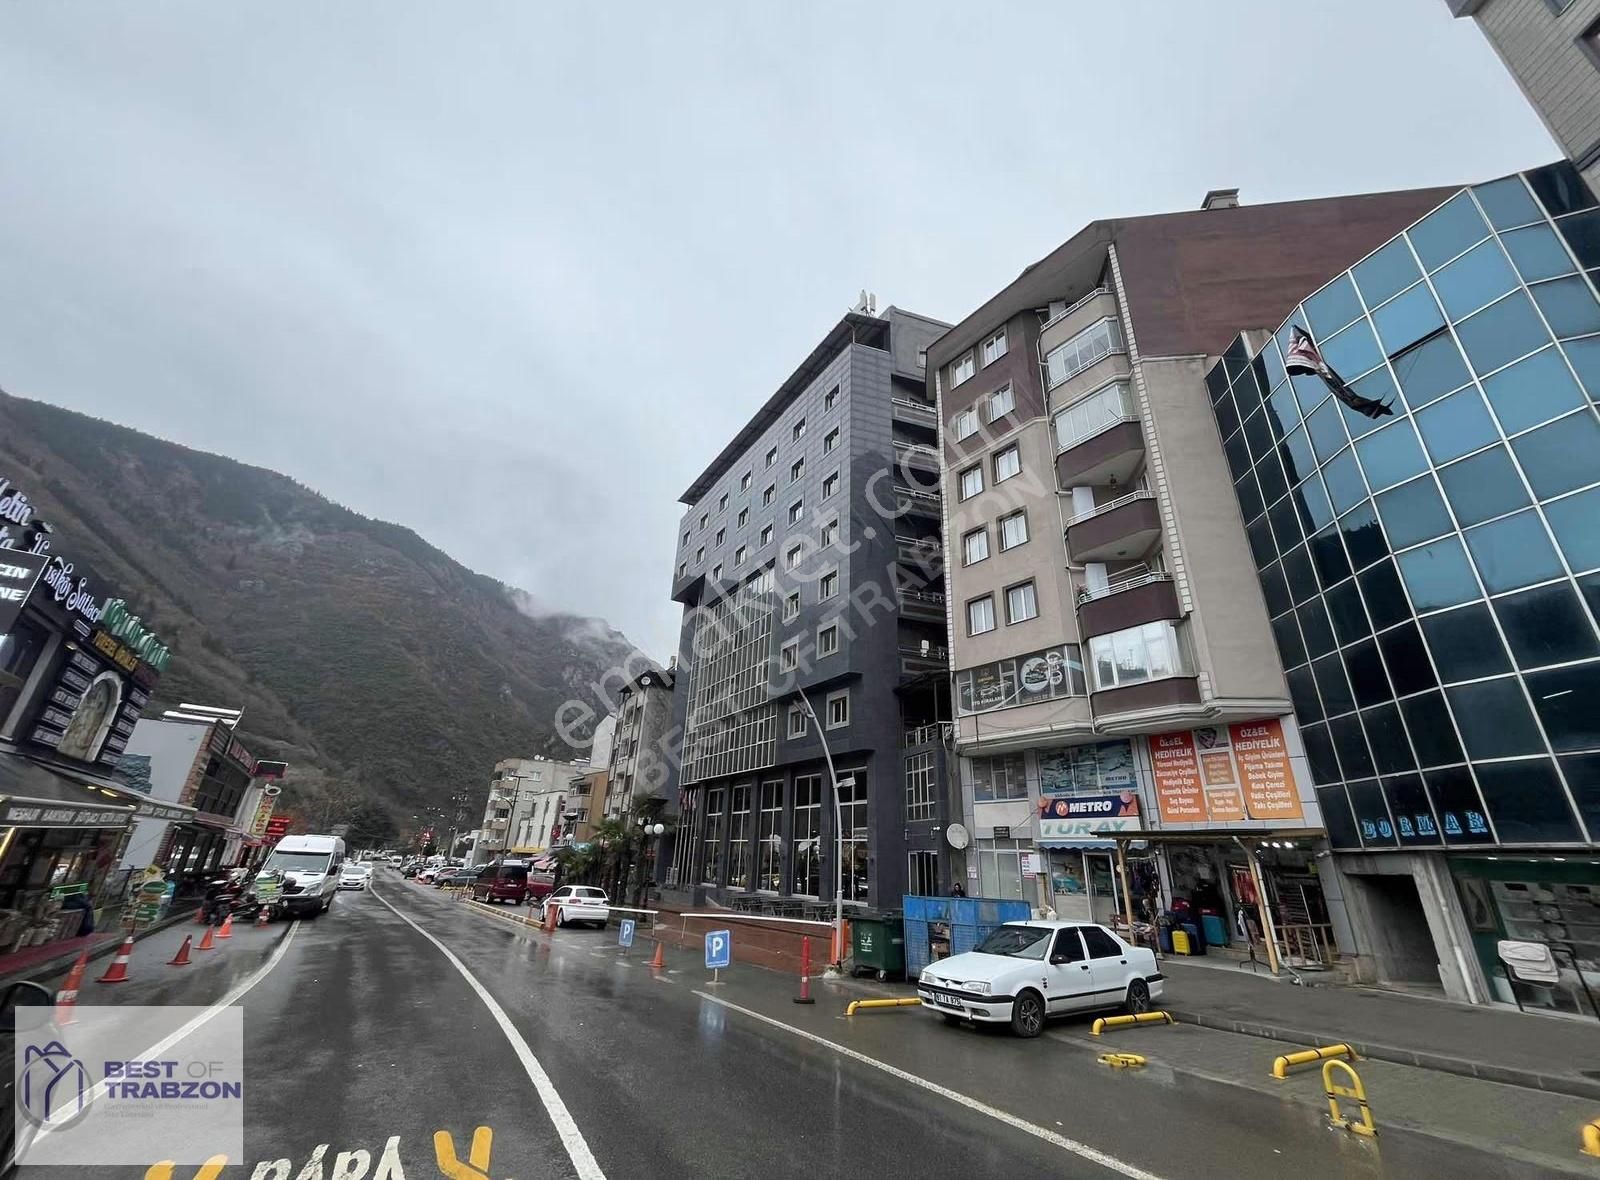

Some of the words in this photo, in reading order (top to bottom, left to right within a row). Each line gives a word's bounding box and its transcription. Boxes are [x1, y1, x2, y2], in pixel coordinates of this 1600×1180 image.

[1068, 801, 1112, 813] METRO
[623, 924, 631, 938] P
[712, 937, 723, 957] P
